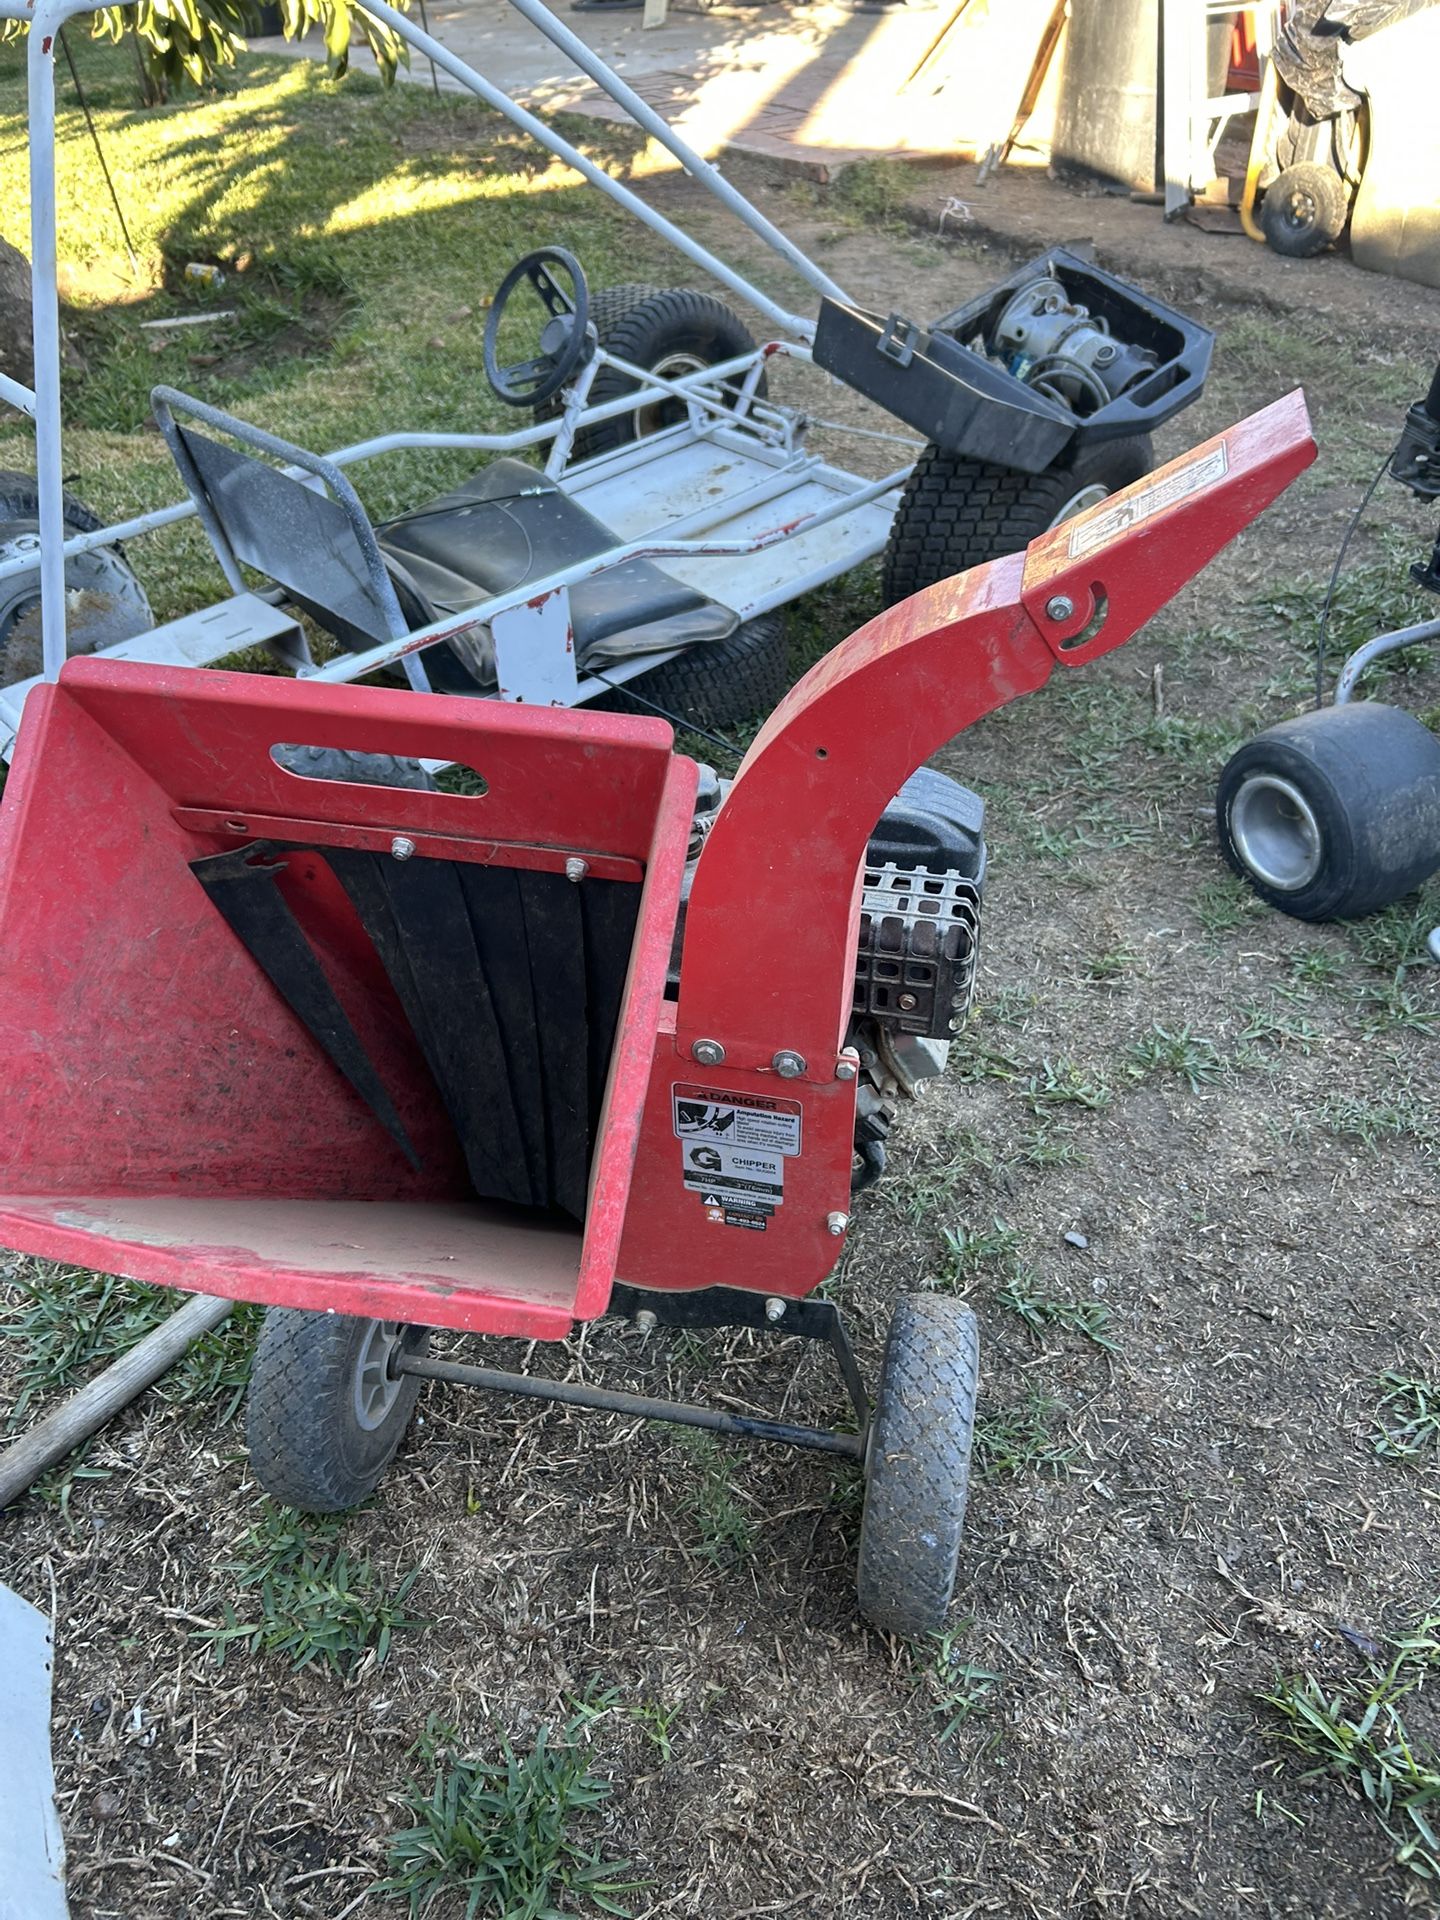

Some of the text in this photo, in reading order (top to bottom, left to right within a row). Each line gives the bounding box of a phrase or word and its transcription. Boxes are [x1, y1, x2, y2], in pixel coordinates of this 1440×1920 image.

[710, 1092, 777, 1110] DANGER
[736, 1109, 794, 1123] Amputation Hazard
[731, 1157, 776, 1170] CHIPPER
[721, 1196, 757, 1207] WARNING
